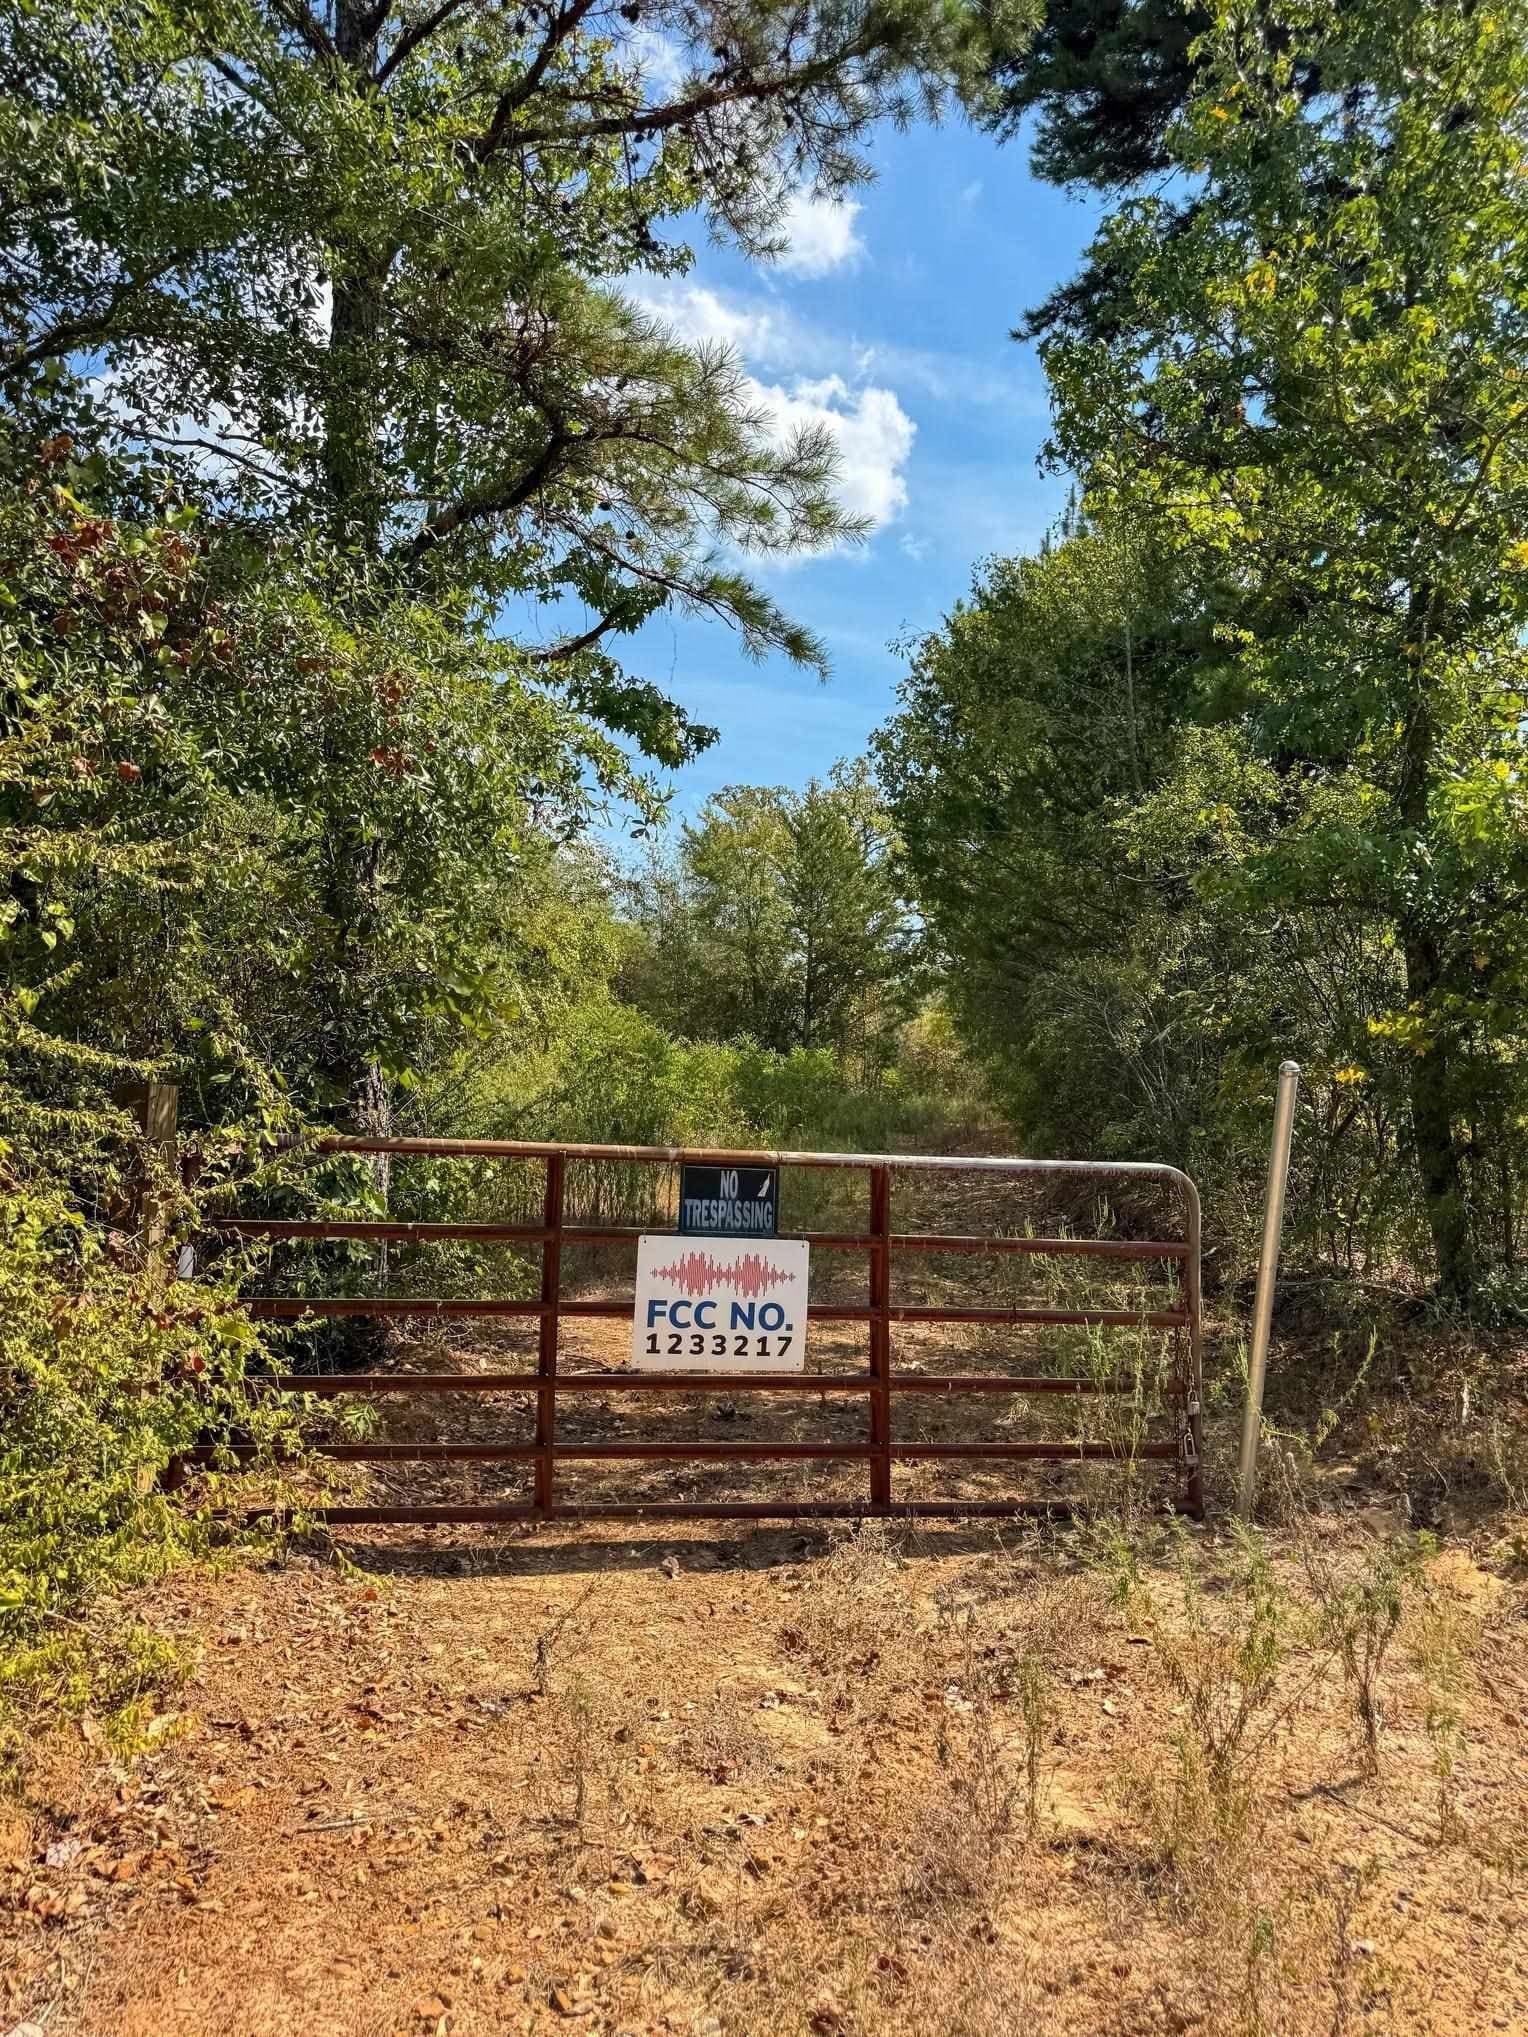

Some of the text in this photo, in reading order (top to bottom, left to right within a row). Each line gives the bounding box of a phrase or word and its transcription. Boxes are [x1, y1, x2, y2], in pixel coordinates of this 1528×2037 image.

[720, 1170, 739, 1199] NO
[684, 1199, 773, 1229] TRESPASSING
[647, 1299, 793, 1331] FCC NO.
[646, 1333, 793, 1356] 1233217
